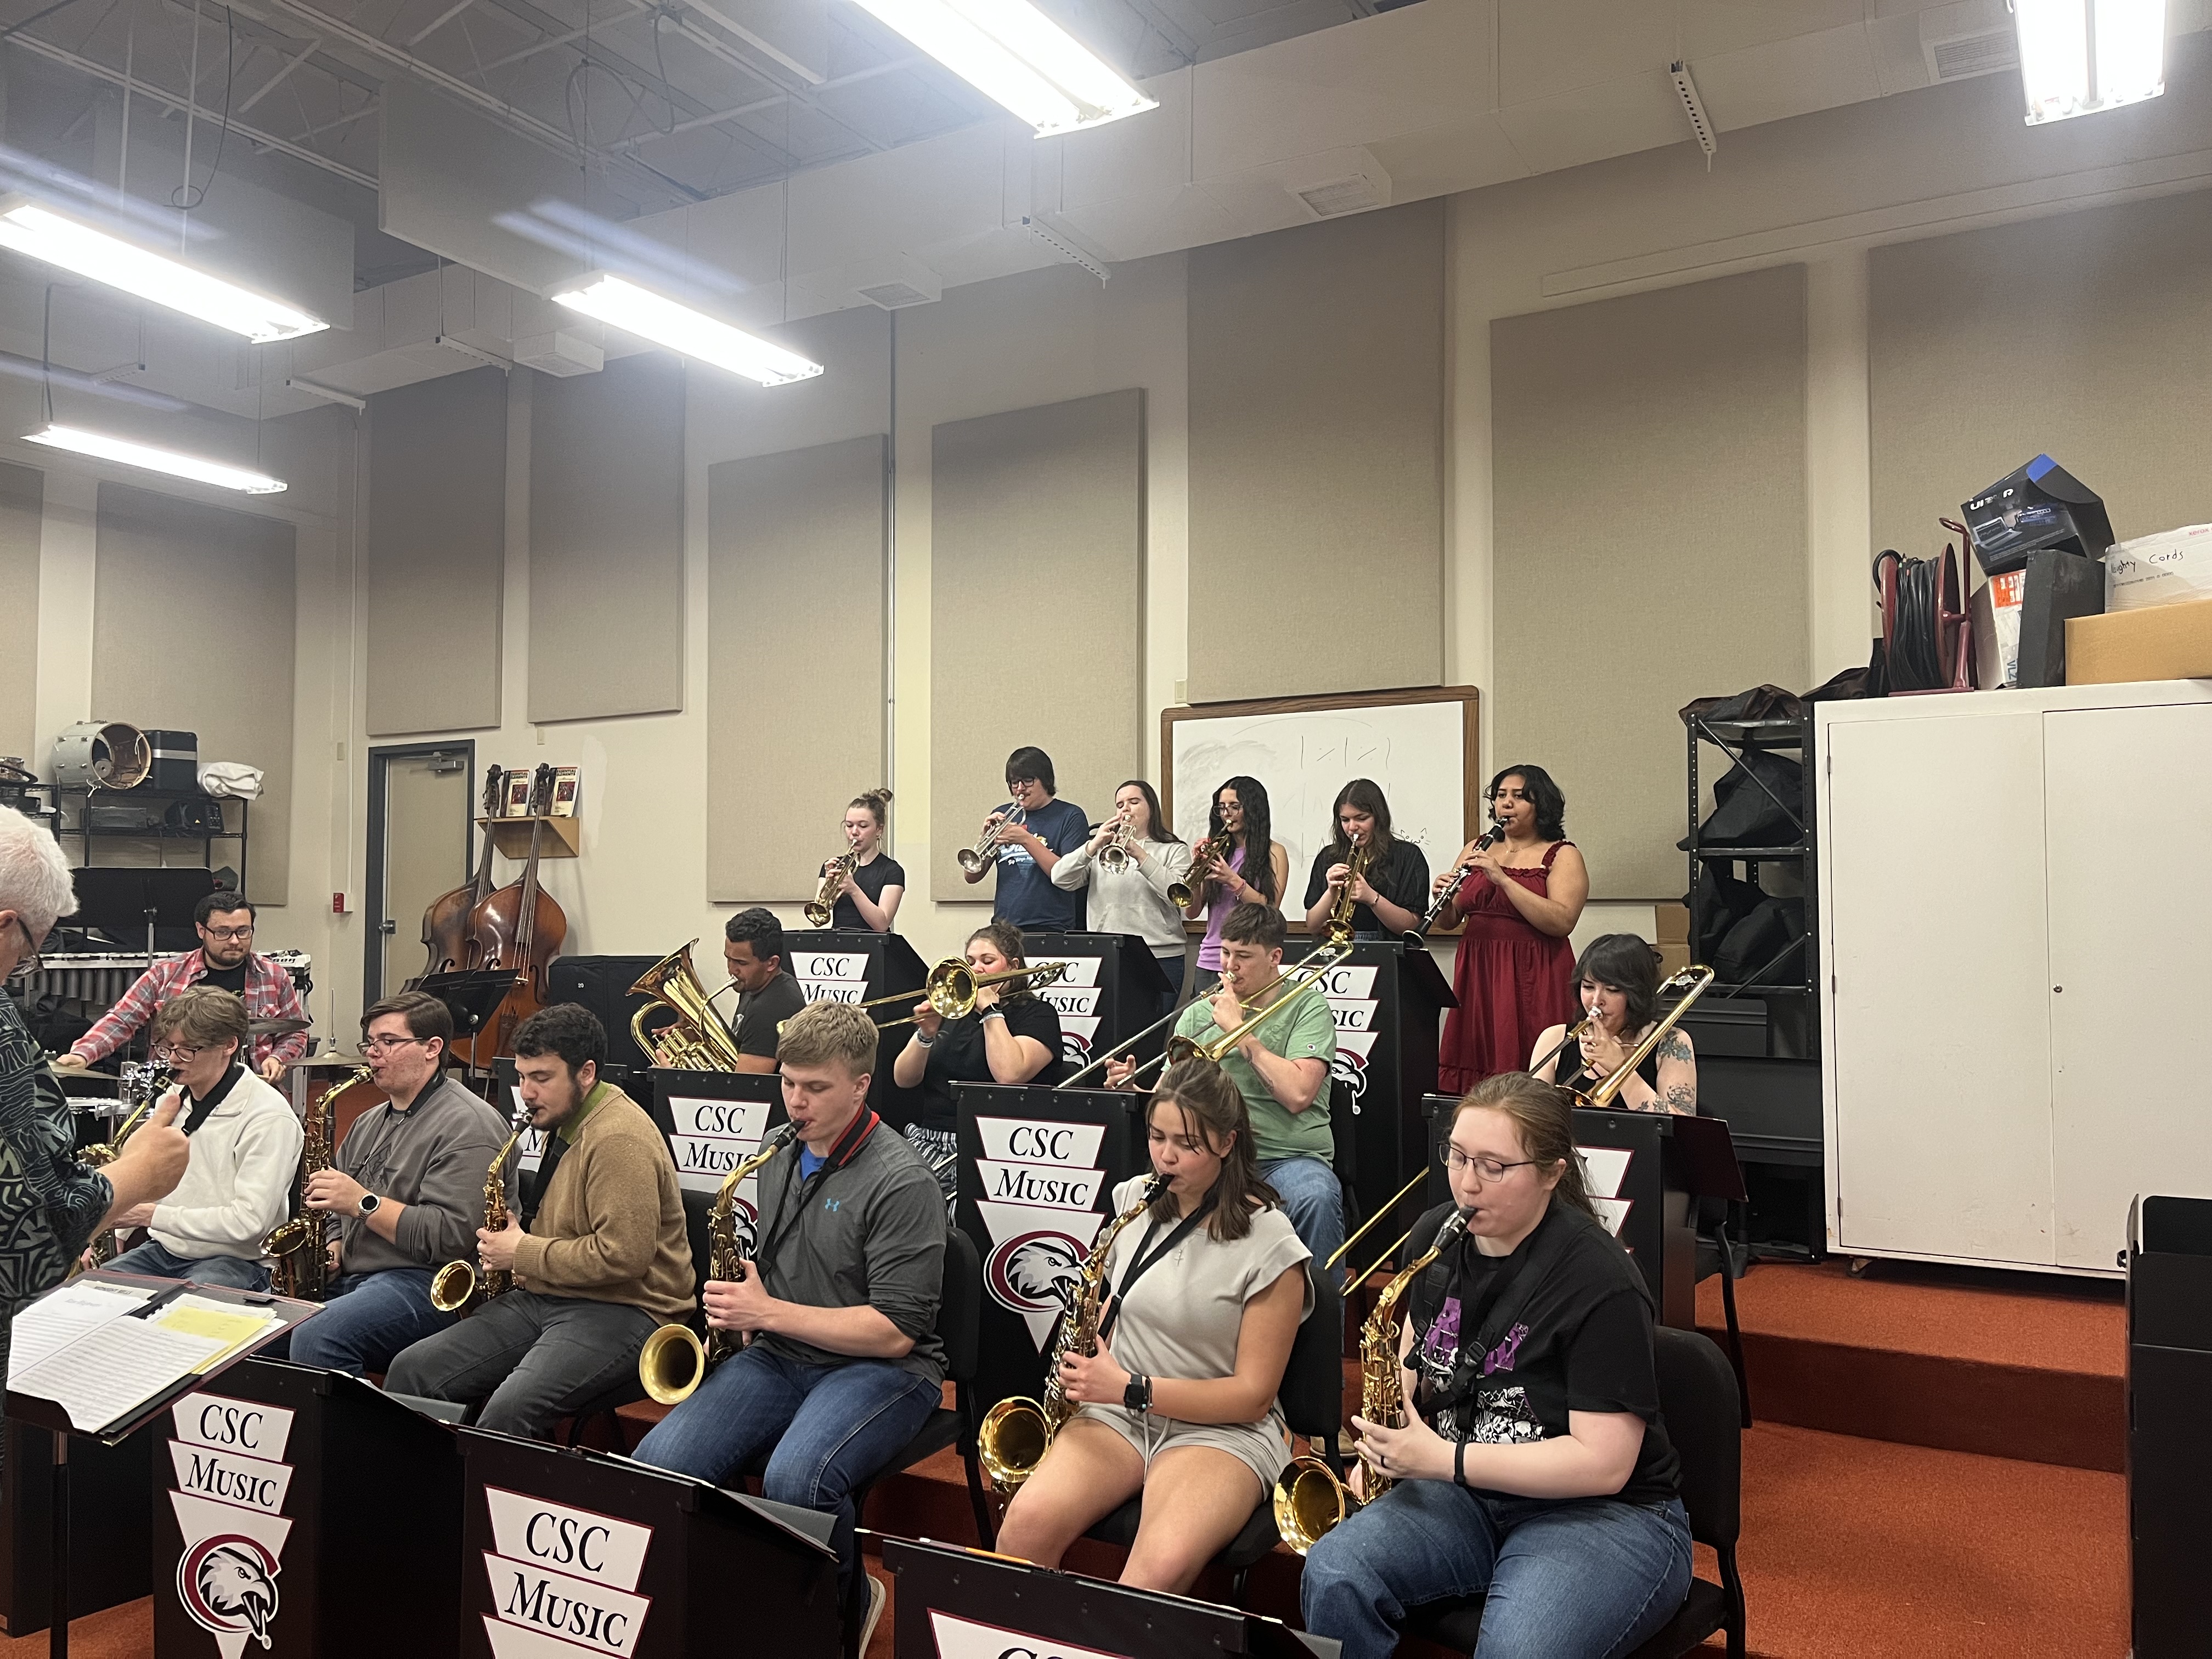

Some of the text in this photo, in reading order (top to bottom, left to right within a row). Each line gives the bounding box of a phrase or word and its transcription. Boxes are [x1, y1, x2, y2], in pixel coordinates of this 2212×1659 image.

[2188, 528, 2209, 536] xerox
[2149, 549, 2183, 563] Cords
[810, 957, 850, 977] CSC
[1032, 962, 1079, 983] CC
[1331, 1010, 1364, 1027] SIC
[695, 1105, 746, 1133] CSC
[1009, 1127, 1074, 1160] CSC
[994, 1169, 1088, 1205] MUSIC
[200, 1404, 263, 1449] CSC
[185, 1454, 277, 1508] MUSIC
[525, 1512, 610, 1573] CSC
[511, 1572, 628, 1649] MUSIC
